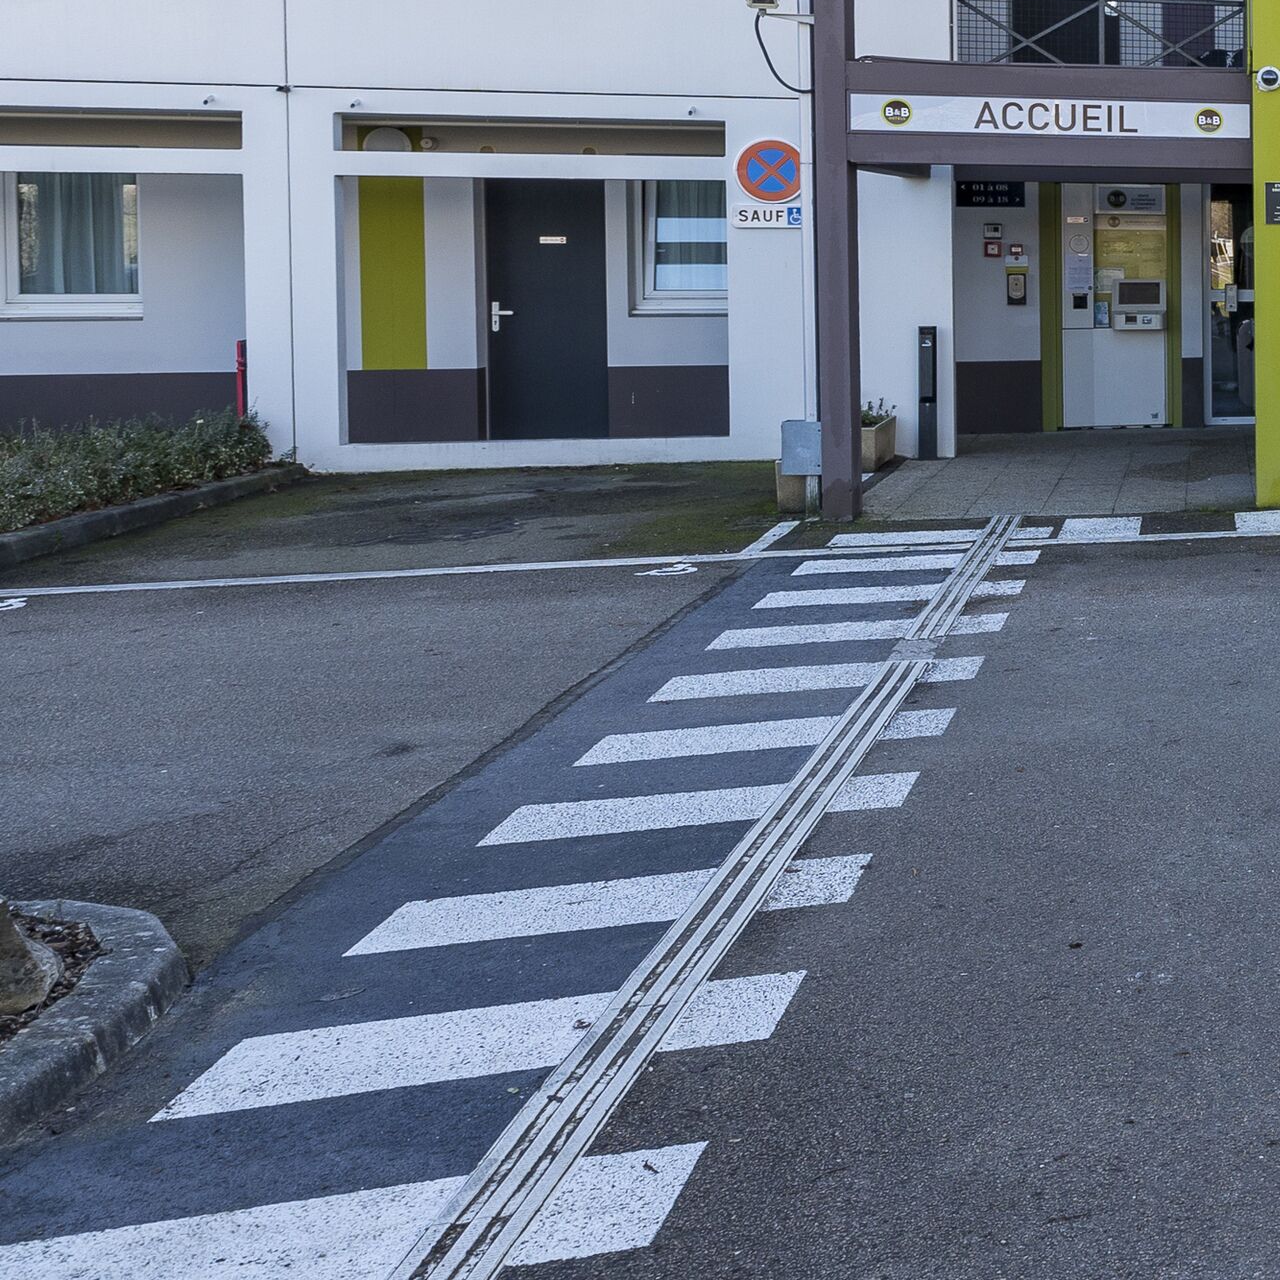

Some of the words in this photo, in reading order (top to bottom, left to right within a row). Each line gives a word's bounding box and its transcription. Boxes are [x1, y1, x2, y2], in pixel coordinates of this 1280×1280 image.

[885, 106, 910, 118] B&B
[974, 101, 1138, 133] ACCUEIL
[1198, 115, 1220, 126] B&B
[738, 210, 784, 222] SAUF
